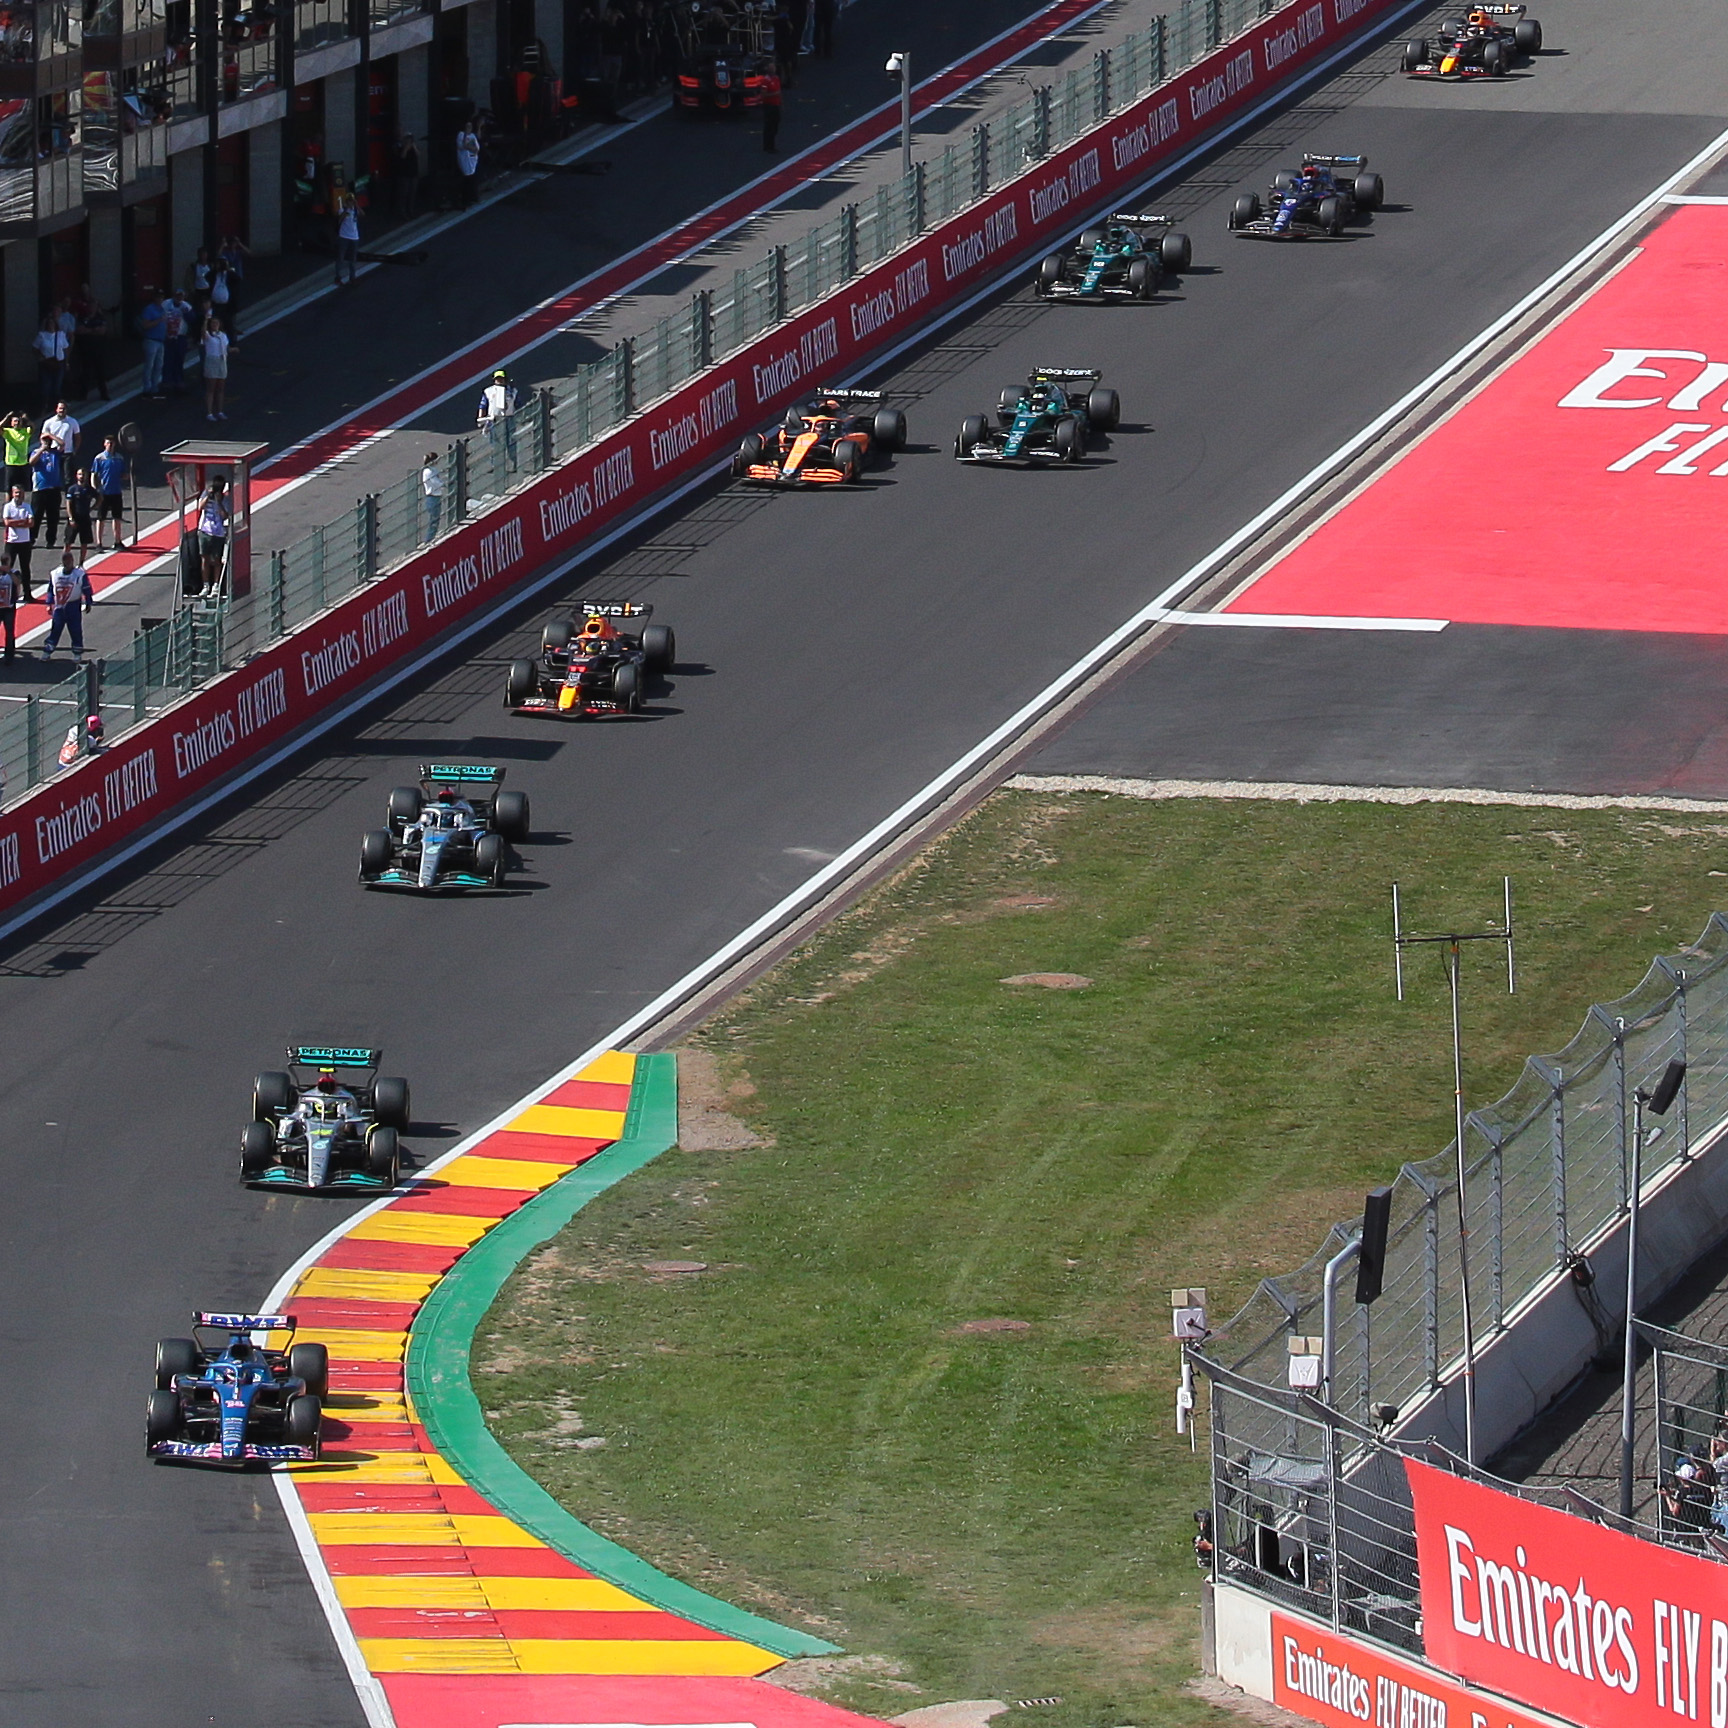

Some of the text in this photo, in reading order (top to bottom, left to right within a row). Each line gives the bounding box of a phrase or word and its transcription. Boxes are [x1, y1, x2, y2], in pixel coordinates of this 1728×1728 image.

[1029, 177, 1070, 225] Emirates
[942, 230, 984, 281] Emirates
[753, 316, 838, 404] Emirates FLY BETTER
[850, 288, 894, 341] Emirates
[650, 378, 738, 470] Emirates FLY BETTER
[539, 446, 634, 541] Emirates FLY BETTER
[422, 516, 523, 617] Emirates FLY BETTER
[301, 589, 408, 696] Emirates FLY BETTER
[173, 667, 286, 778] Emirates FLY BETTER
[36, 748, 157, 864] Emirates FLY BETTER
[432, 765, 493, 774] PETRONAS
[302, 1049, 367, 1057] PETRONAS
[210, 1315, 280, 1327] BWT
[1444, 1524, 1640, 1694] Emirates
[1653, 1601, 1703, 1719] FLY
[1283, 1634, 1370, 1723] Emirates
[1375, 1674, 1402, 1728] FLY
